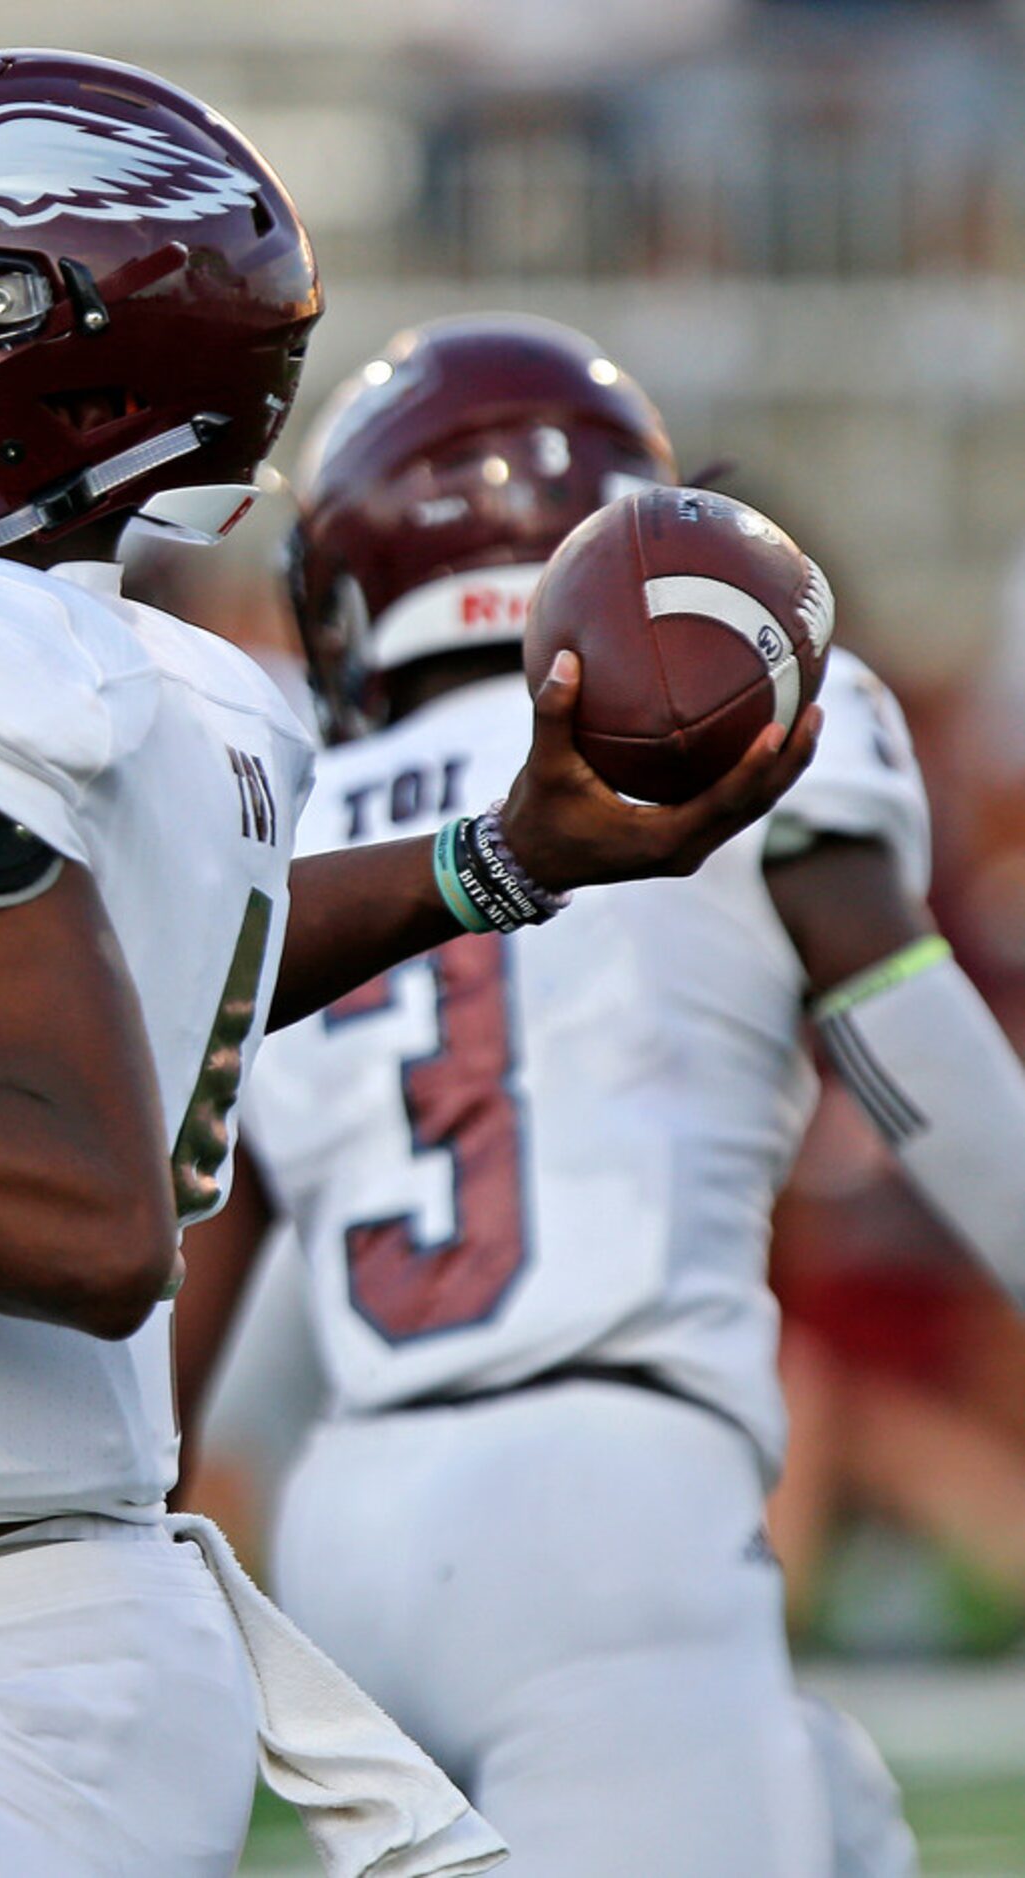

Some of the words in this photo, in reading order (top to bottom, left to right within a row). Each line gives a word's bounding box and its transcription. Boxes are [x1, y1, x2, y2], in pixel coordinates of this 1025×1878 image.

[459, 588, 532, 625] Ri
[343, 758, 469, 840] TOI
[459, 868, 491, 907] BITE
[322, 930, 535, 1348] 3
